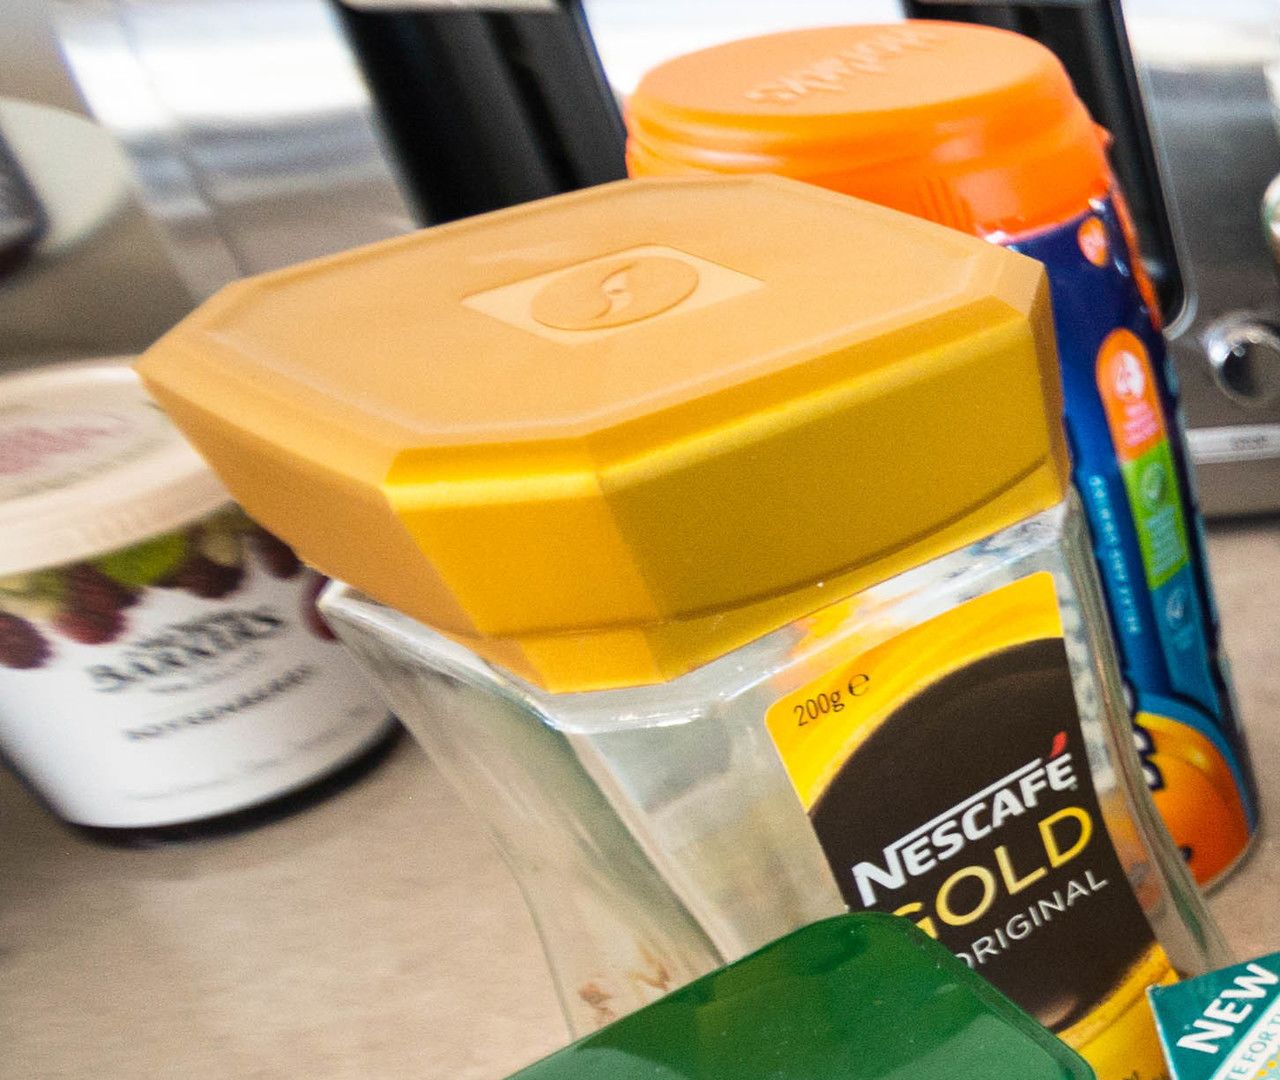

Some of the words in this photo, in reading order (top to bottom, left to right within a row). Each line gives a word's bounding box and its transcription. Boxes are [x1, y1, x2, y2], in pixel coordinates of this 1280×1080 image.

[792, 688, 846, 729] 200g
[850, 730, 1077, 909] NESCAFÉ
[1175, 962, 1280, 1056] NEW
[1247, 1031, 1275, 1065] FOR
